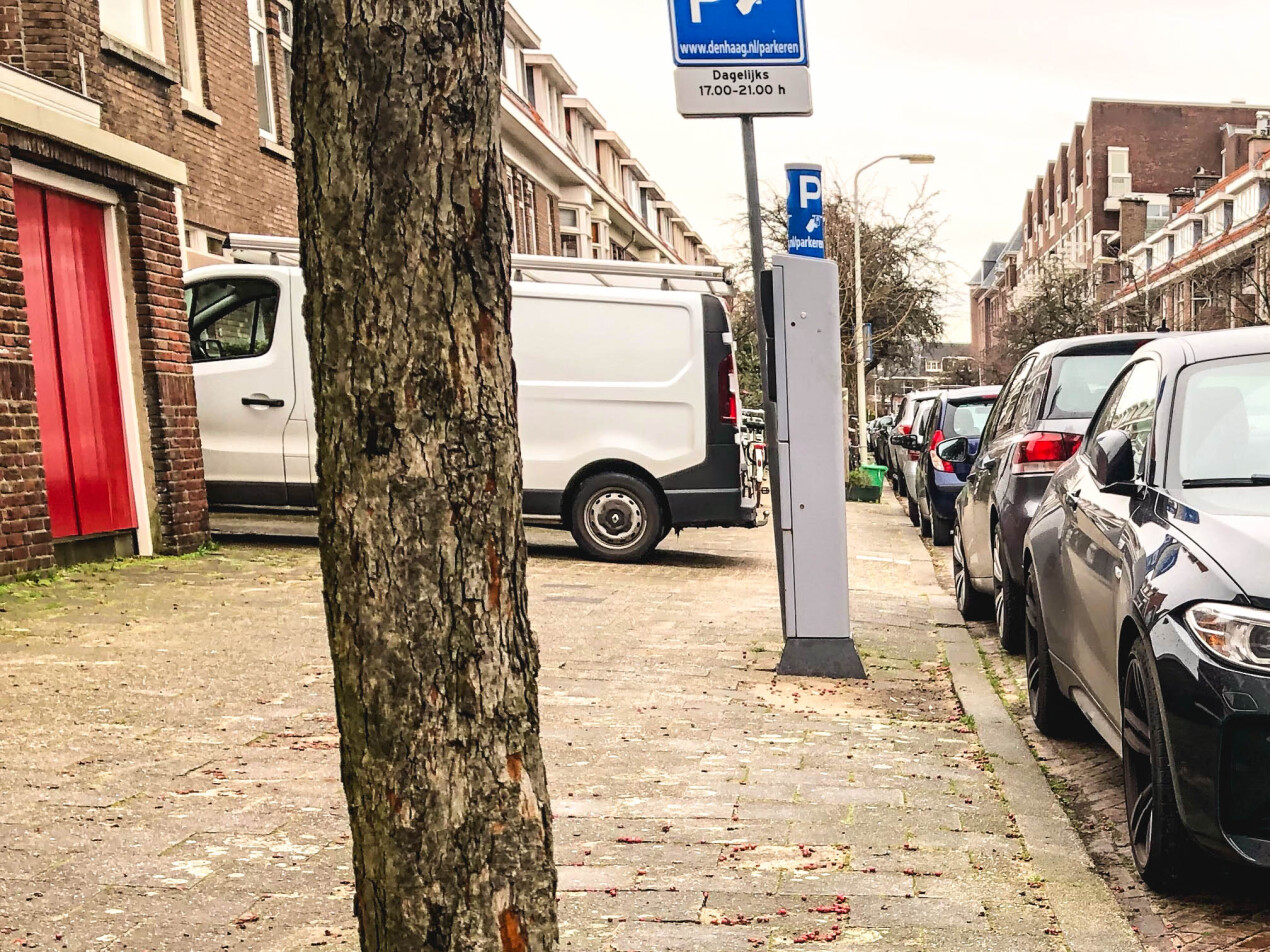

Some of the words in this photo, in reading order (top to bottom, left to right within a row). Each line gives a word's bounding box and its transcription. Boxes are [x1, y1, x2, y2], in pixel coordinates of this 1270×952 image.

[680, 40, 799, 57] www.denhaag.nl/parkeren
[713, 70, 769, 83] Dagelijks
[699, 85, 773, 96] 17.00-21.00
[778, 85, 786, 95] h
[800, 175, 822, 209] P
